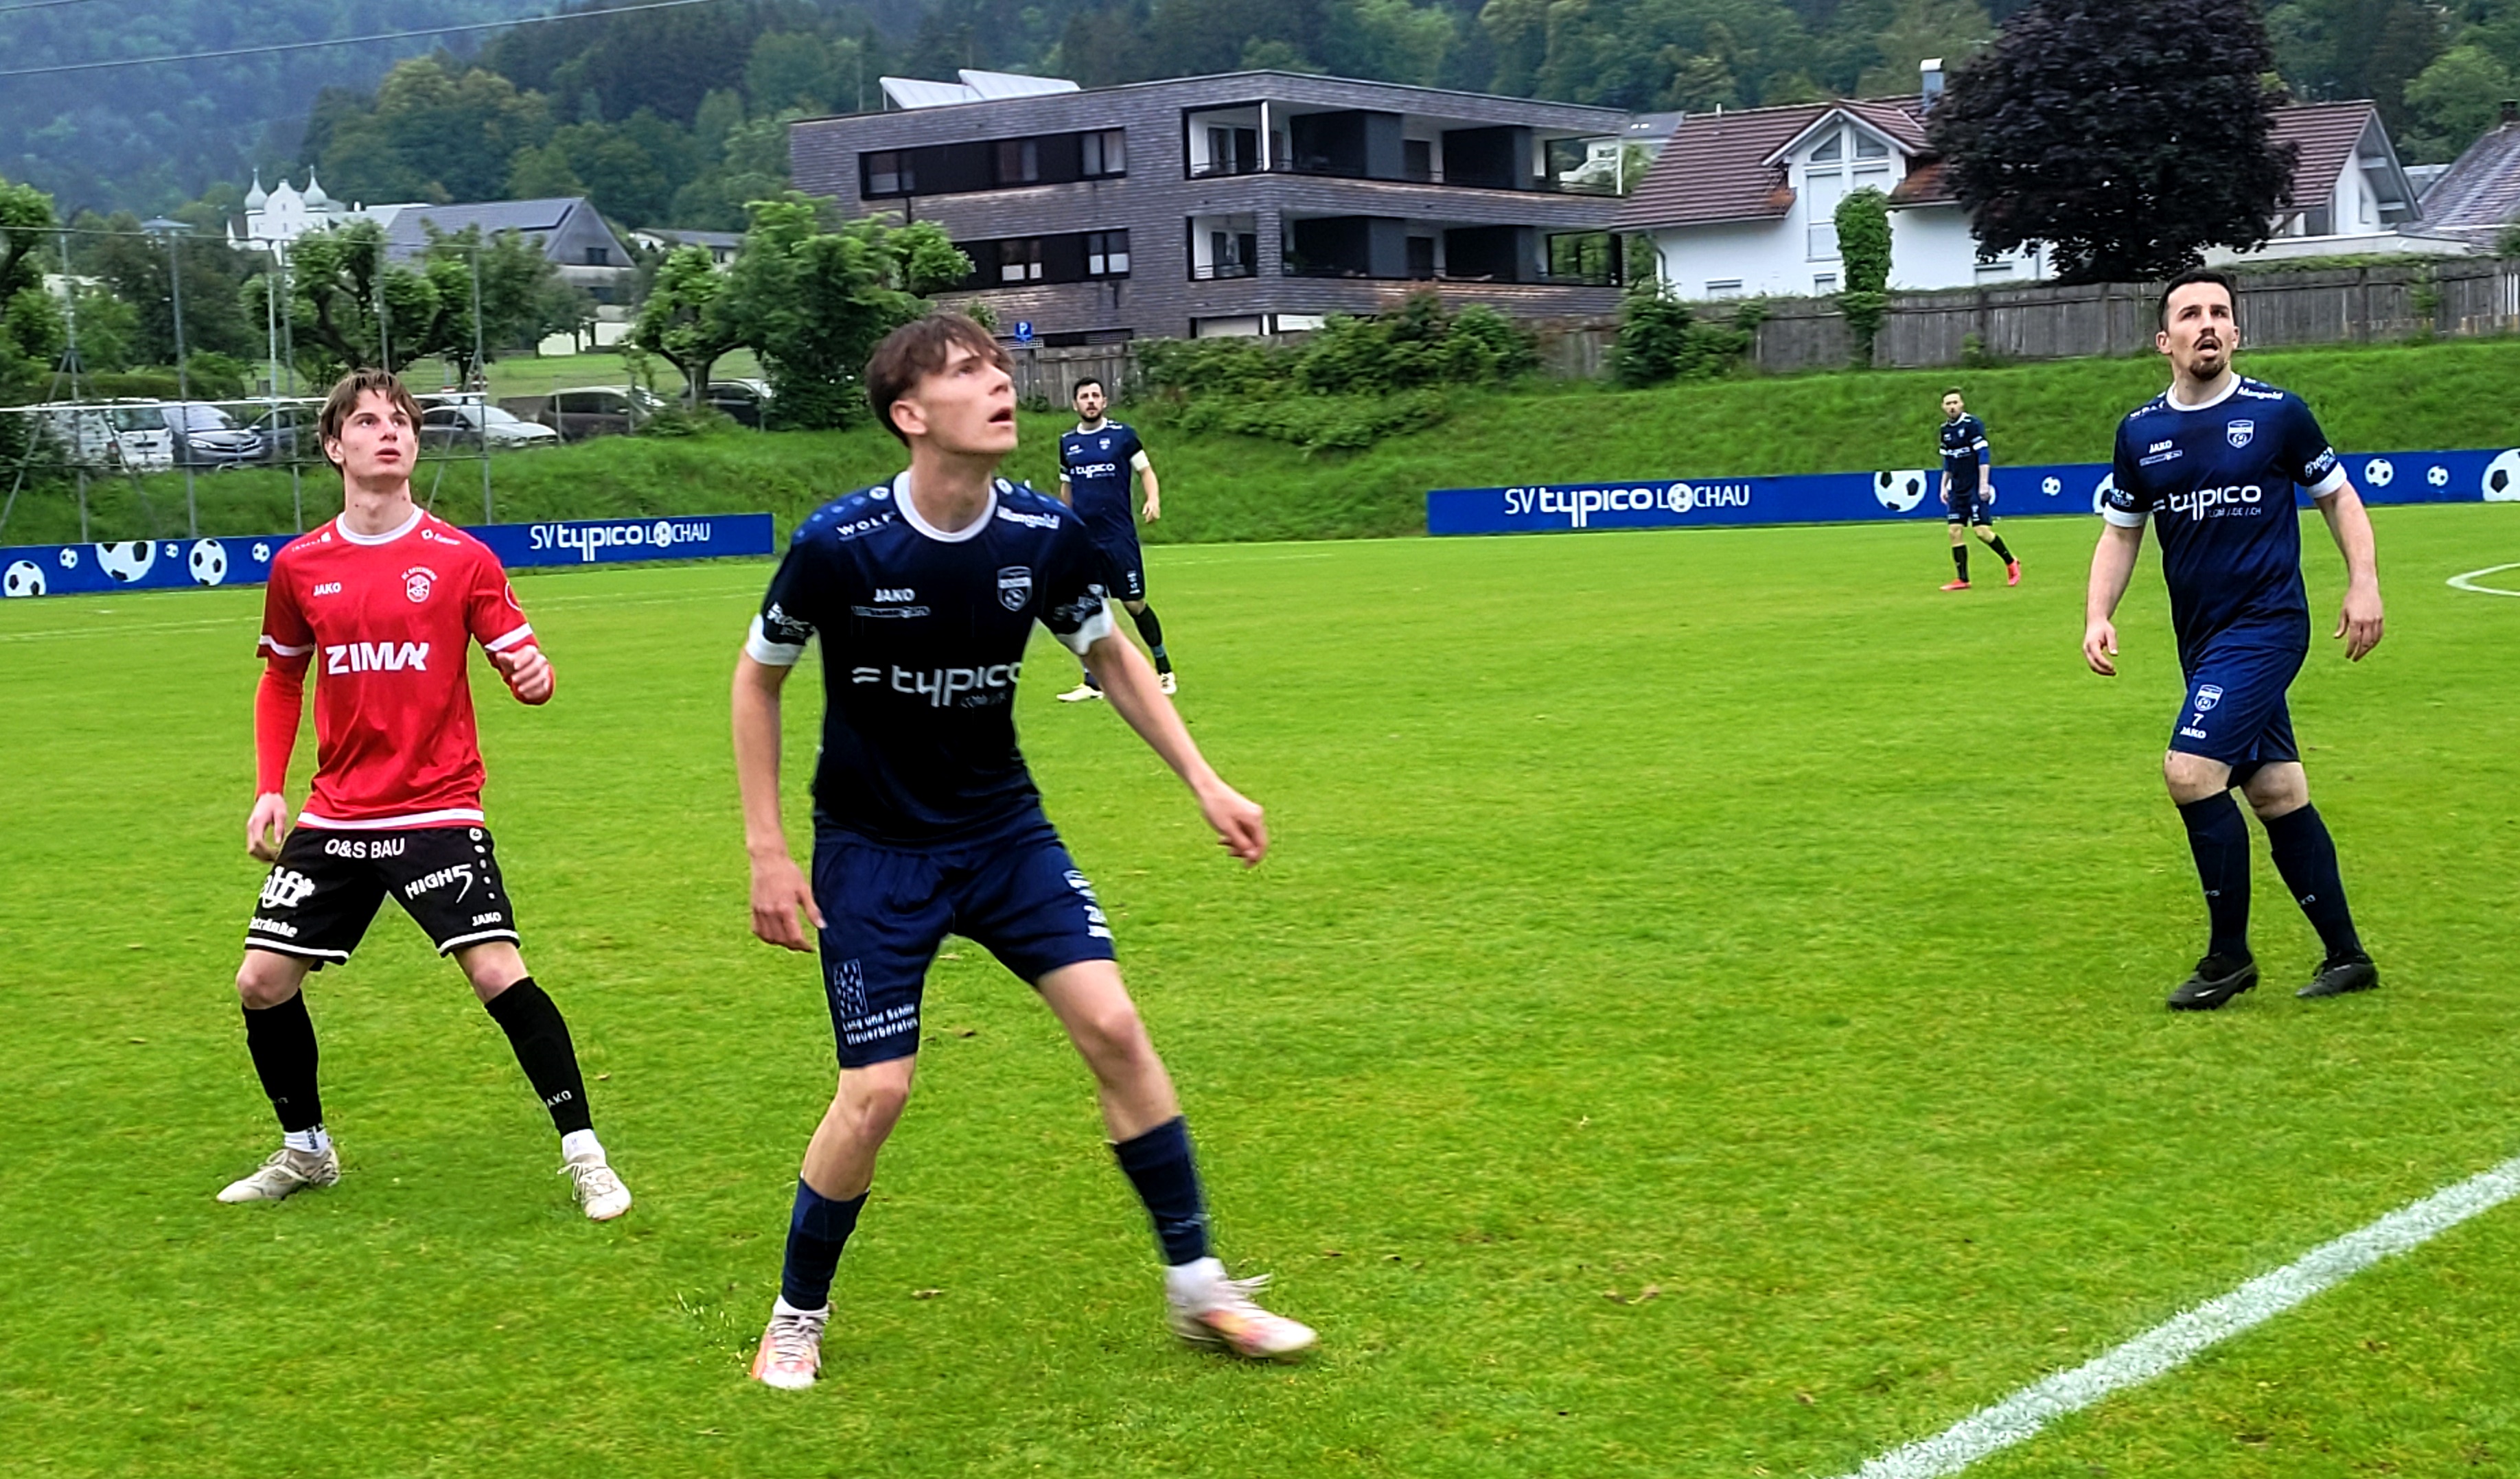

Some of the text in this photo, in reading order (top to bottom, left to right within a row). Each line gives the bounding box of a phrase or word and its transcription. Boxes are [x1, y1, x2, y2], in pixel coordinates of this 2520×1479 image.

[1019, 322, 1028, 335] P
[1505, 487, 1535, 514] SV
[1538, 487, 1654, 528] typico
[2168, 485, 2261, 520] typico
[530, 524, 555, 550] SV
[557, 524, 643, 561] typico
[313, 582, 342, 596] JAKO
[873, 588, 916, 602] JAKO
[2192, 713, 2204, 726] 7
[2180, 726, 2206, 739] JAKO
[325, 837, 405, 859] O&S BAU
[472, 911, 502, 926] JAKO
[546, 1090, 573, 1108] AKO
